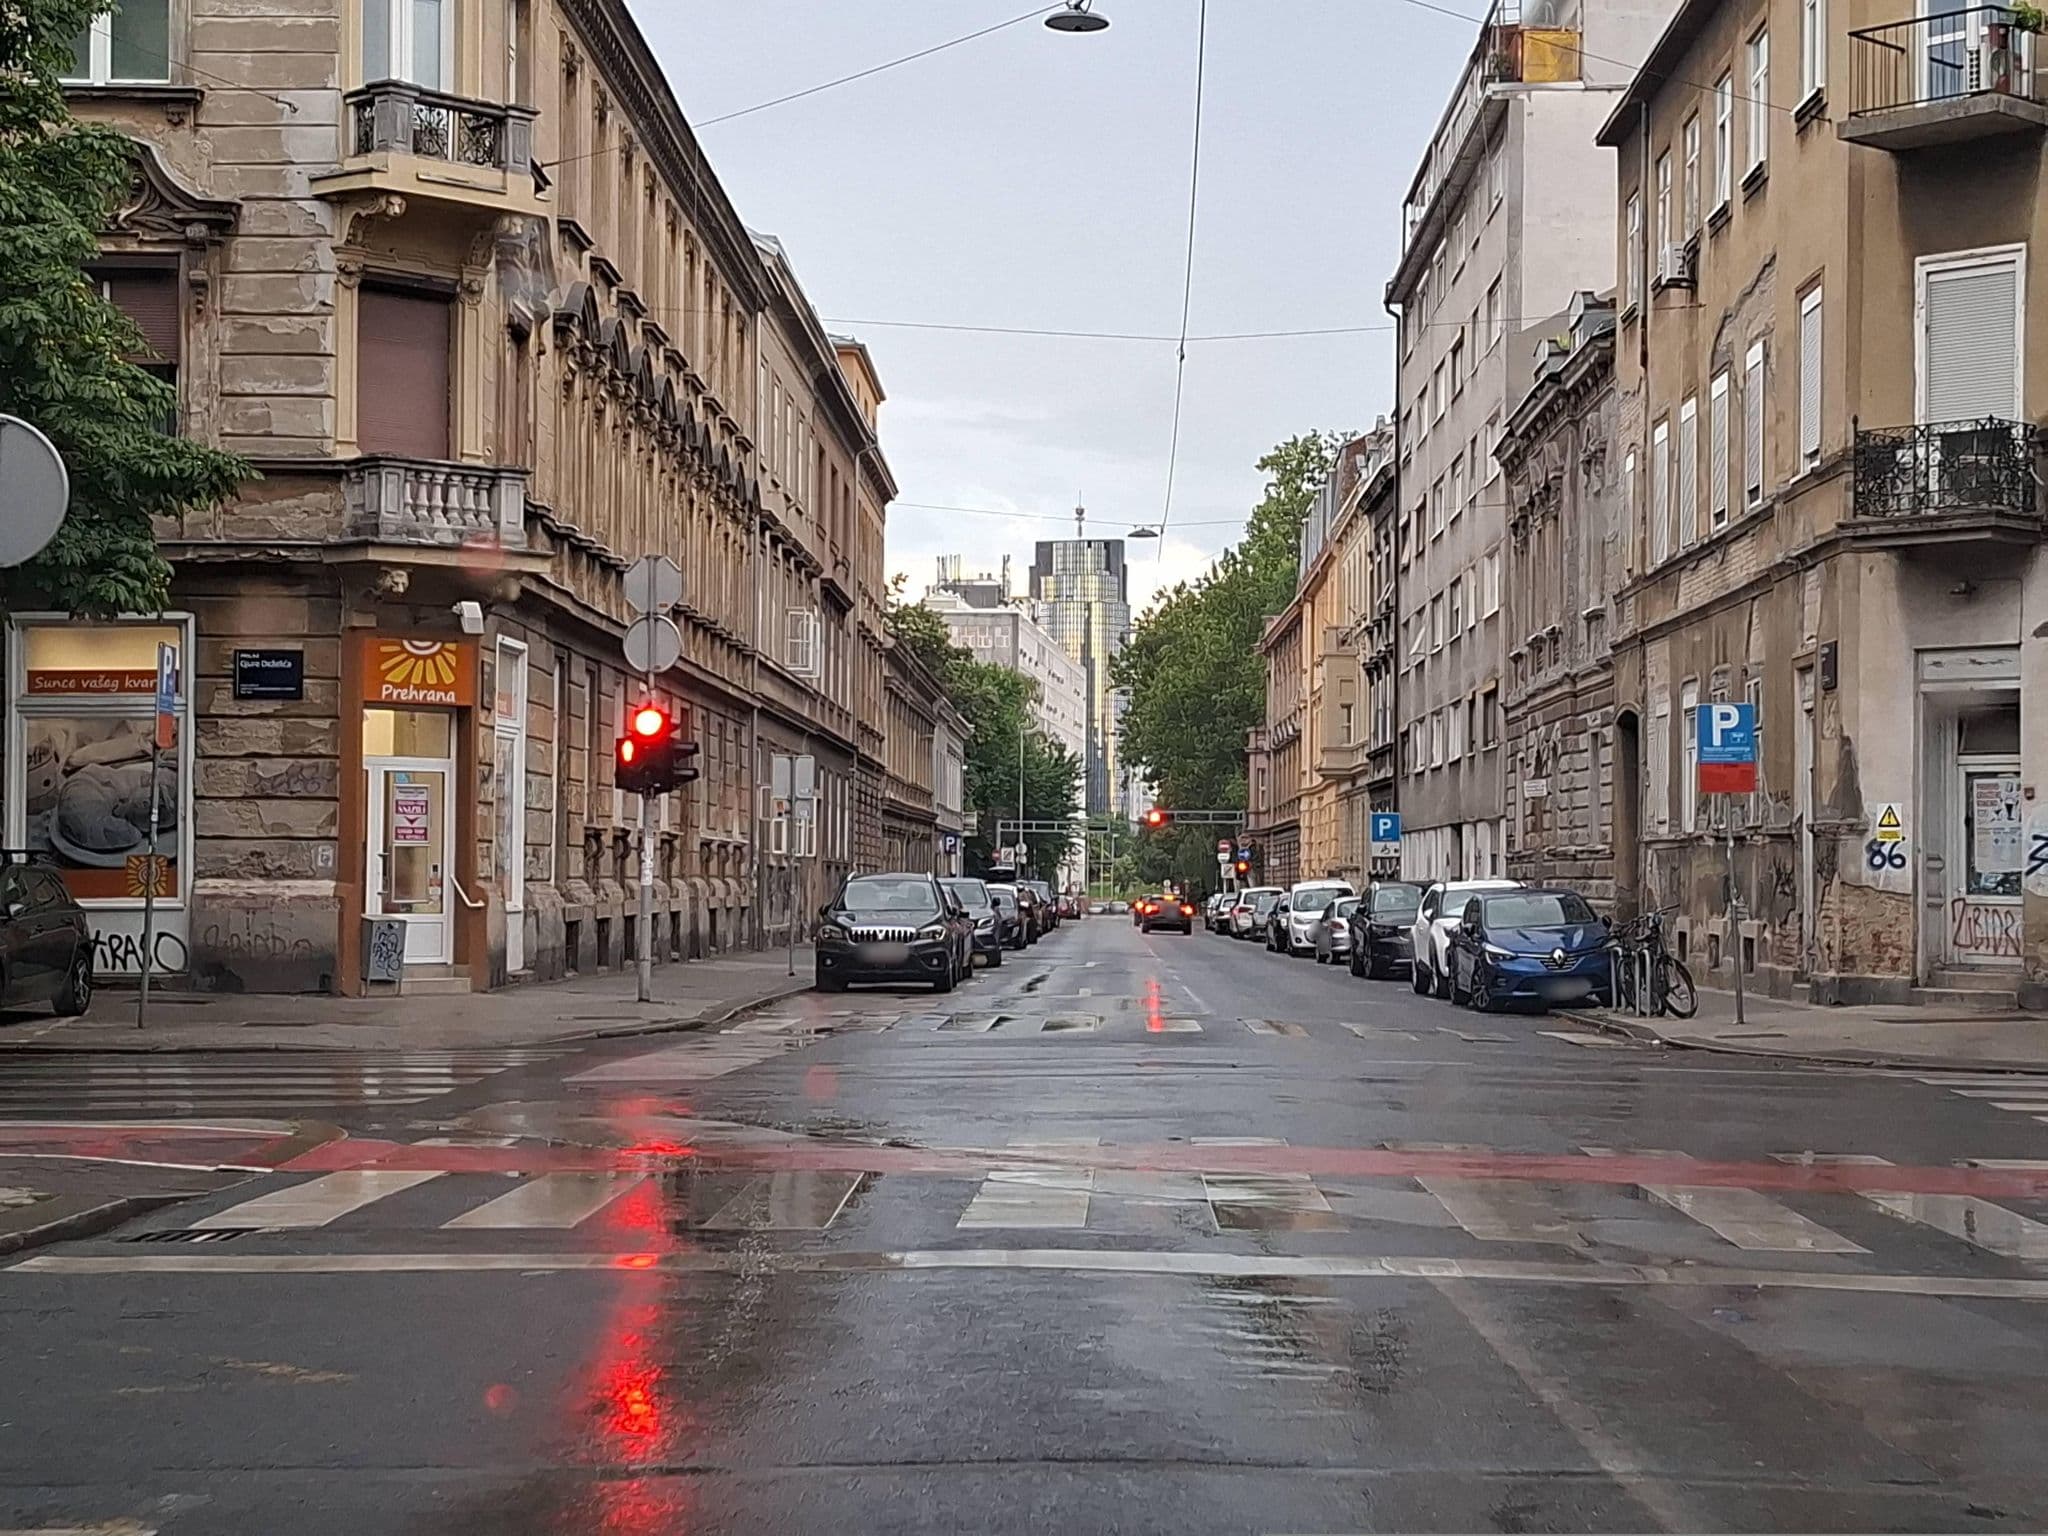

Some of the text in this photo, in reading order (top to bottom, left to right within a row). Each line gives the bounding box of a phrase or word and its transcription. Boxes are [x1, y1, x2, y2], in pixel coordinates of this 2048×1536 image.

[34, 673, 157, 691] Sunce vašeg kvar
[382, 684, 456, 703] Prehrana
[1712, 705, 1740, 746] P
[1379, 818, 1392, 836] P
[946, 836, 956, 853] P
